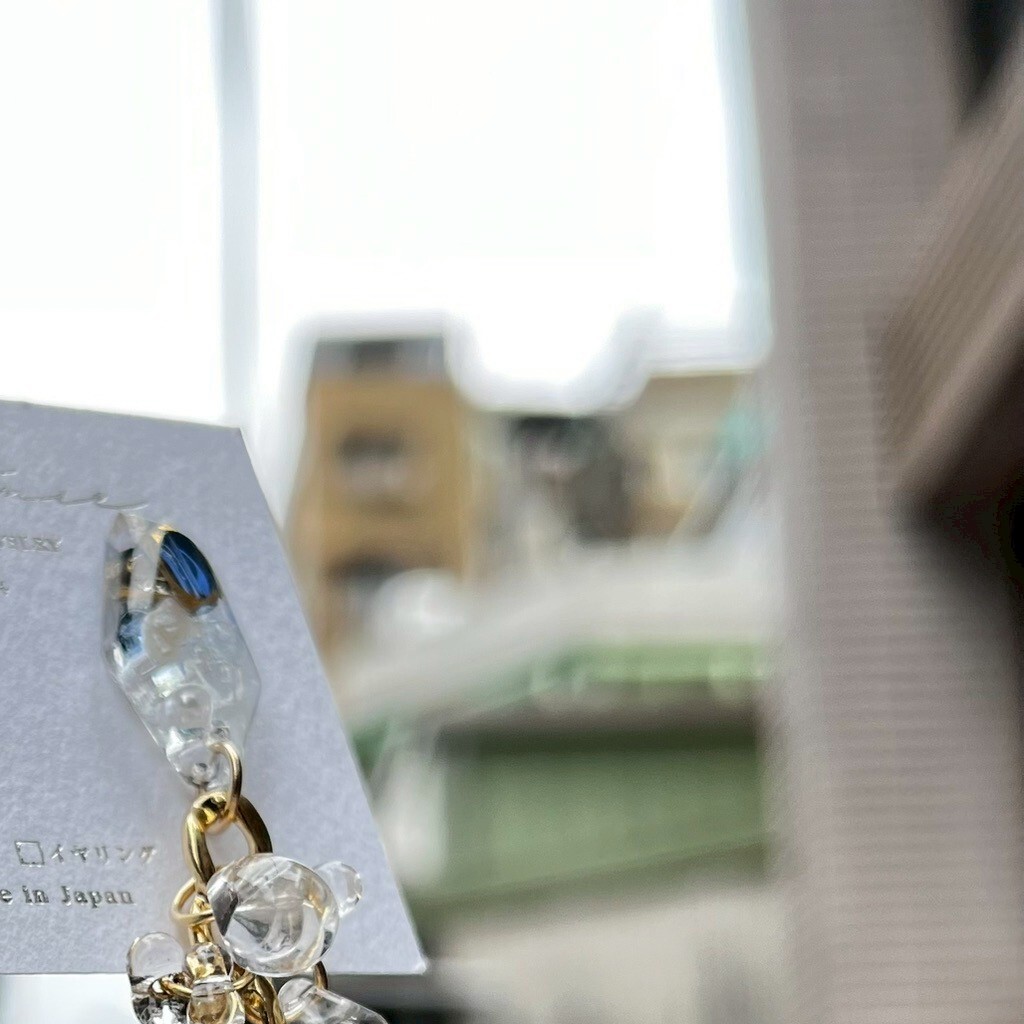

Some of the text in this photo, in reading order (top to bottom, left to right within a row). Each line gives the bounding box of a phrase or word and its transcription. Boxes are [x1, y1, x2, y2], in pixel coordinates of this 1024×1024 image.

[51, 843, 158, 866] イヤリング
[24, 884, 50, 905] in
[60, 884, 136, 909] Japan
